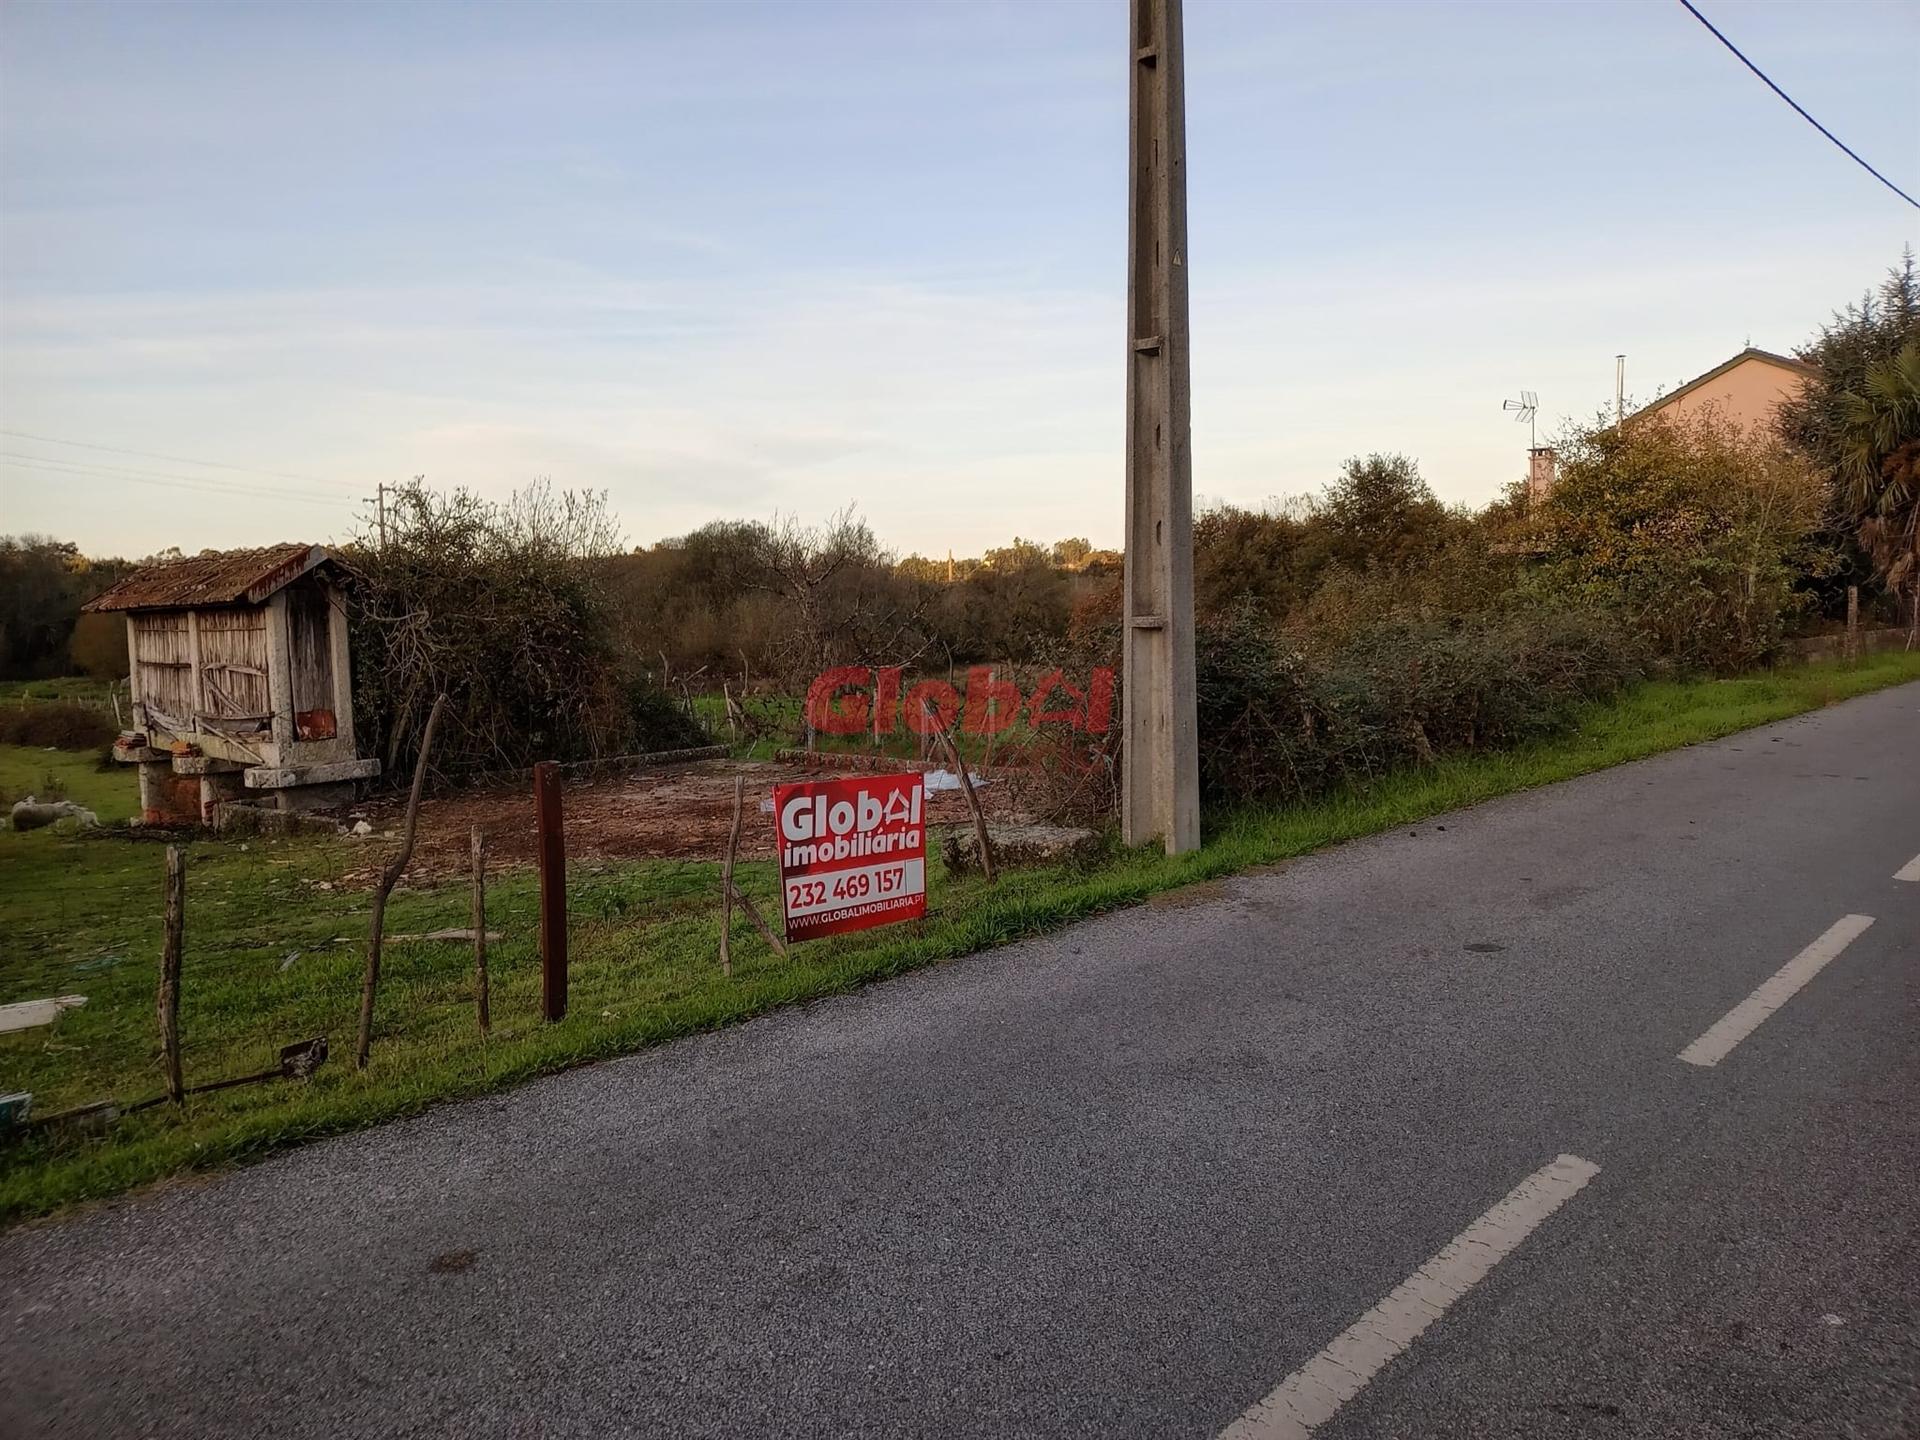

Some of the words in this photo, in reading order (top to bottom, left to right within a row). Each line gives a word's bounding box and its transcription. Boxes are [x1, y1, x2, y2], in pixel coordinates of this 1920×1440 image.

[784, 827, 920, 868] imobiliária
[789, 881, 827, 909] 232
[833, 874, 870, 900] 469
[875, 868, 904, 893] 157
